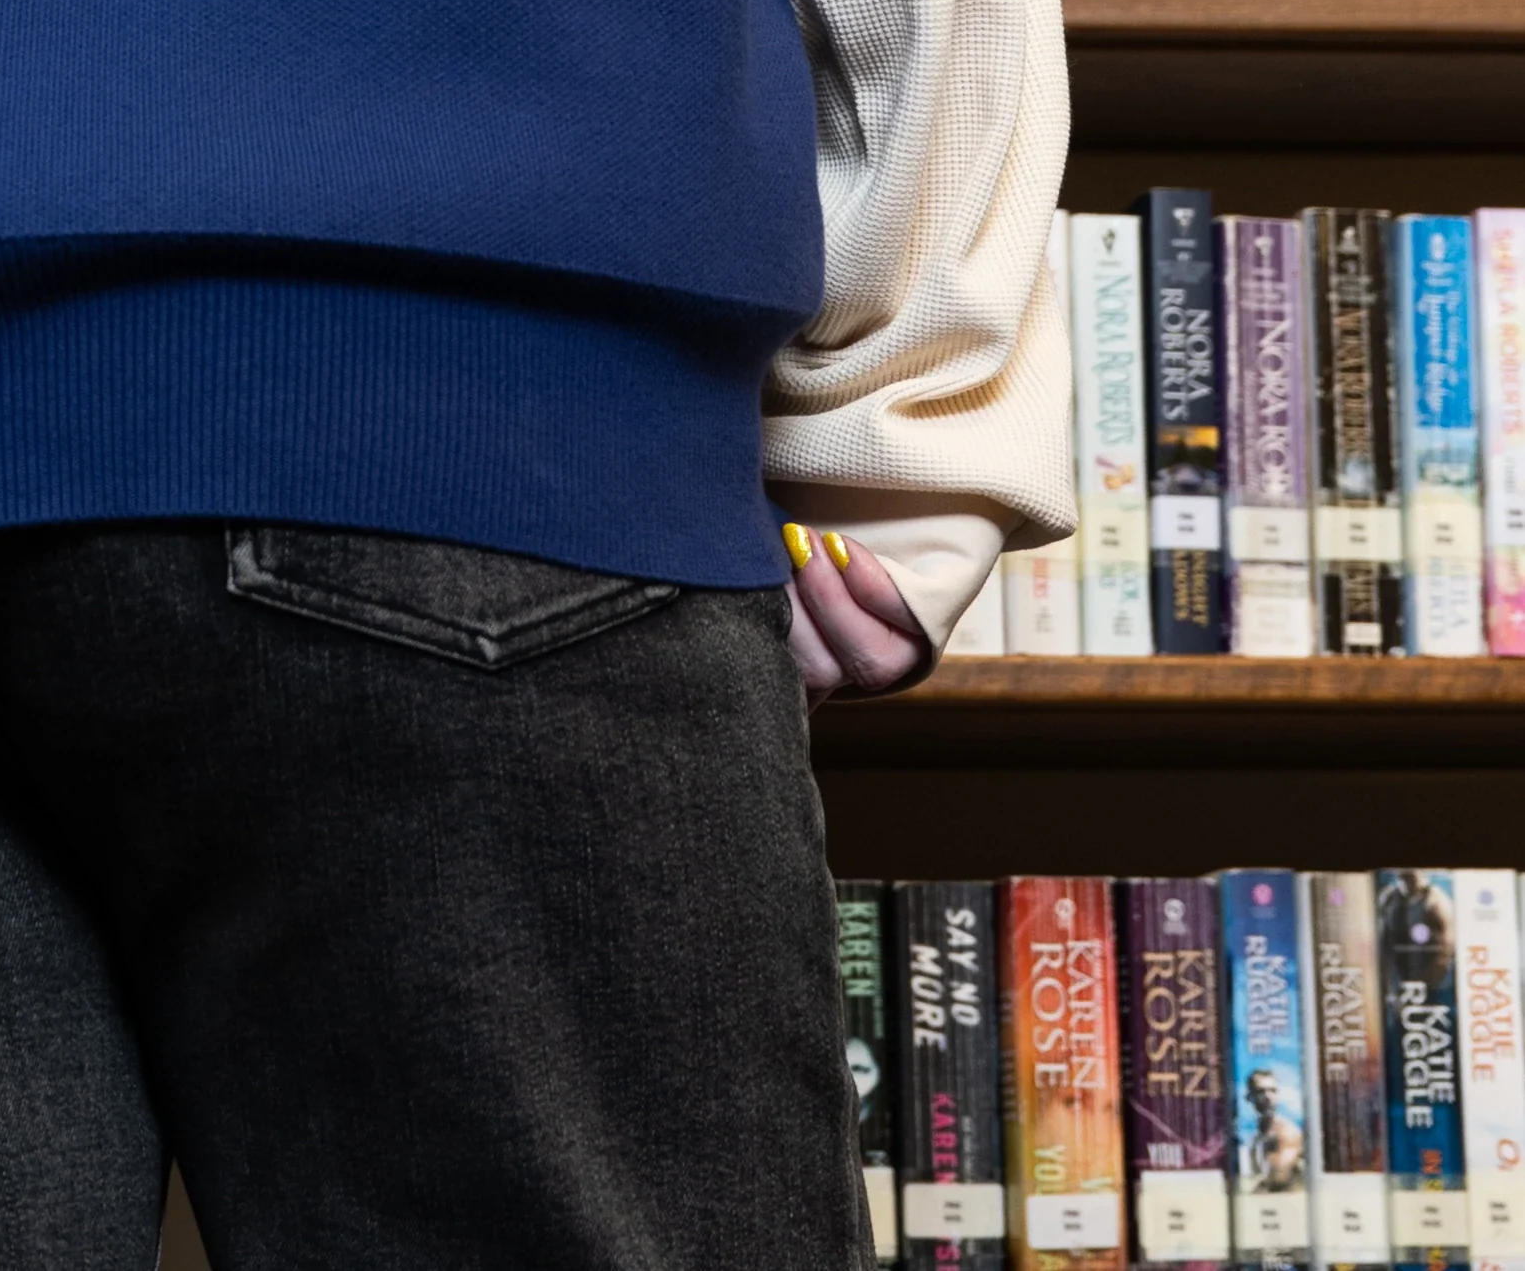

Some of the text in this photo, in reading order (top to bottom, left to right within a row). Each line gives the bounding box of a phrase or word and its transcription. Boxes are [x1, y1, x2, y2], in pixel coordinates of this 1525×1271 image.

[1091, 274, 1136, 445] NORA ROBERTS
[1159, 287, 1213, 421] NORA ROBERTS
[1254, 319, 1293, 411] NORA
[836, 901, 876, 998] KAREN
[910, 943, 948, 1053] MORE
[944, 907, 981, 1027] SAY NO
[1244, 934, 1272, 1056] RUGGLE
[1265, 954, 1290, 1038] KATIE
[1029, 940, 1069, 1090] ROSE
[1066, 938, 1103, 1091] KAREN
[1142, 949, 1180, 1098] ROSE
[1175, 947, 1210, 1100] KAREN
[1318, 942, 1350, 1084] RUGGLE
[1343, 965, 1368, 1060] KATIE
[1400, 980, 1433, 1129] RUGGLE
[1425, 1004, 1456, 1105] KATIE
[1464, 945, 1496, 1083] RUGGLE
[1490, 967, 1515, 1060] KATIE
[931, 1091, 959, 1186] KAREN
[1033, 1144, 1067, 1196] YOU
